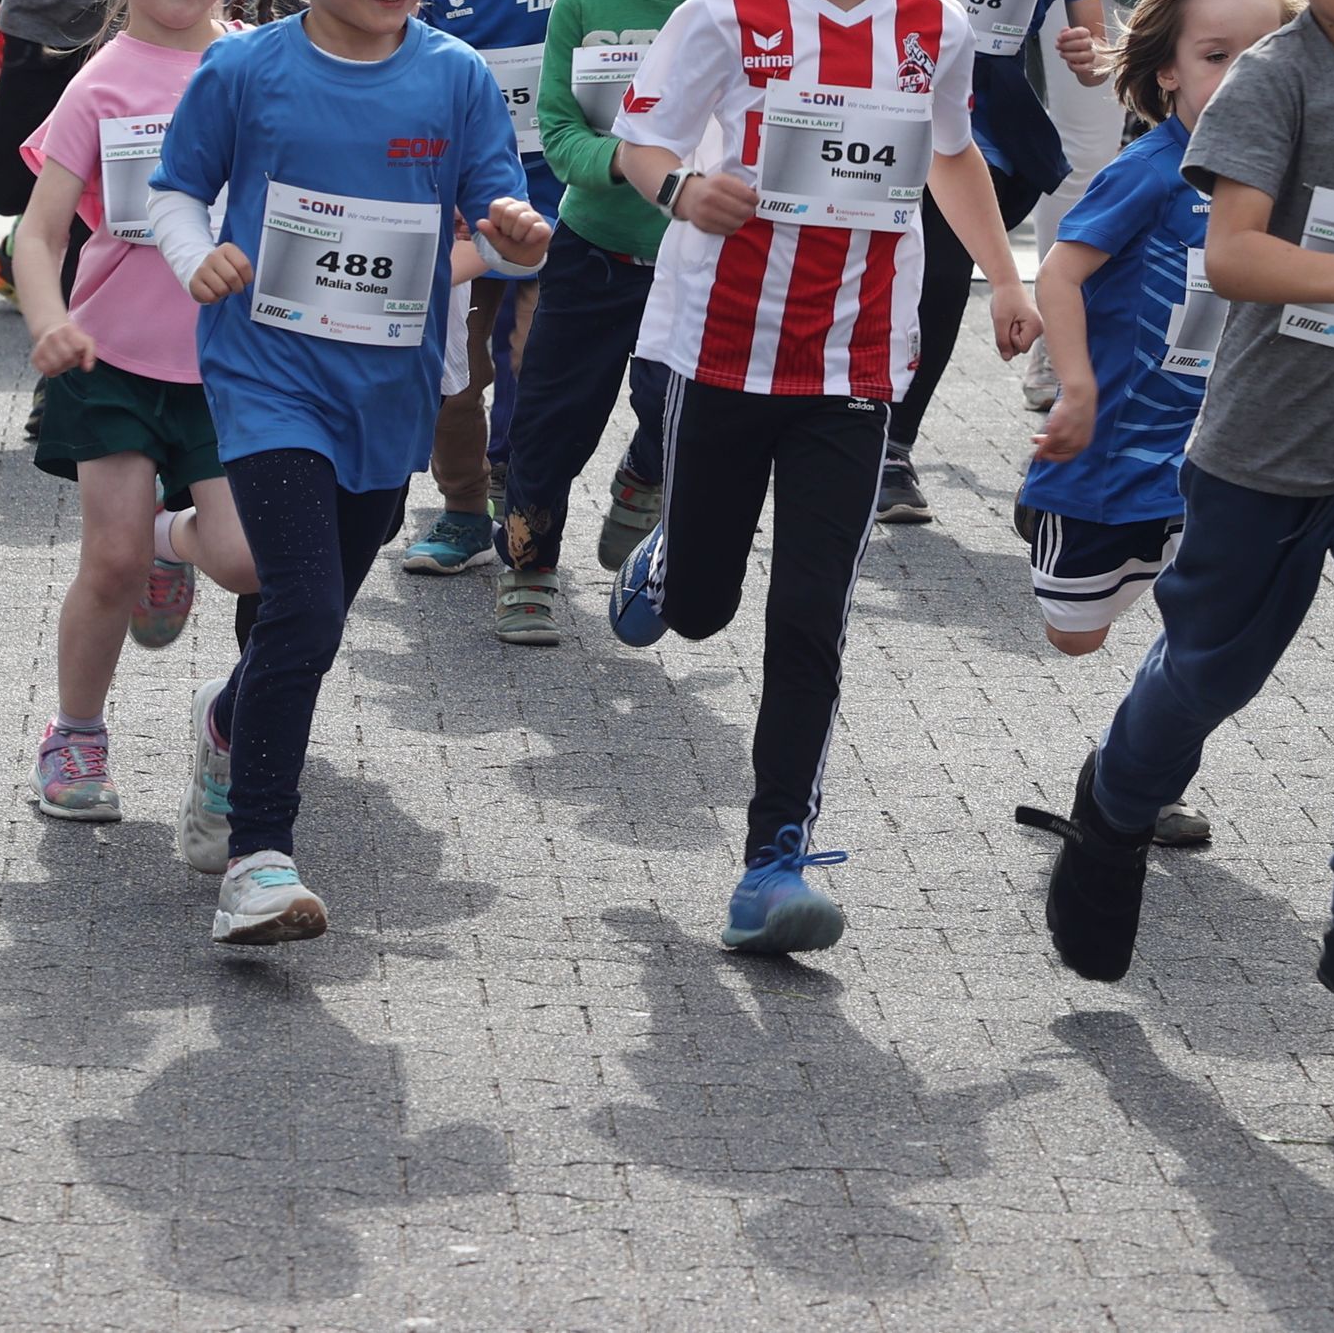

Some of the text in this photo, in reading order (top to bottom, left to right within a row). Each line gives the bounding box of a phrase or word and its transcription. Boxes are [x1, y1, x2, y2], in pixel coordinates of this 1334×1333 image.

[445, 6, 474, 20] erima
[967, 6, 980, 16] Liv
[611, 52, 638, 62] ONI
[743, 52, 795, 69] erima
[812, 92, 845, 107] ONI
[145, 122, 170, 135] ON
[768, 114, 840, 129] LINDLAR LÄUFT
[105, 147, 145, 159] LINDLAR
[820, 139, 897, 167] 504
[830, 167, 882, 183] Henning
[311, 201, 345, 217] ONI
[760, 199, 796, 214] LANG
[1192, 203, 1212, 213] eri
[893, 209, 908, 225] SC
[113, 228, 147, 239] LANG
[268, 217, 338, 239] LINDLAR LÄUFT
[315, 250, 394, 280] 488
[315, 275, 388, 295] Malia Solea
[256, 301, 292, 320] LANG
[387, 323, 401, 338] SC
[1286, 314, 1328, 334] LANG
[1168, 354, 1199, 368] LANG
[848, 402, 876, 411] adidas
